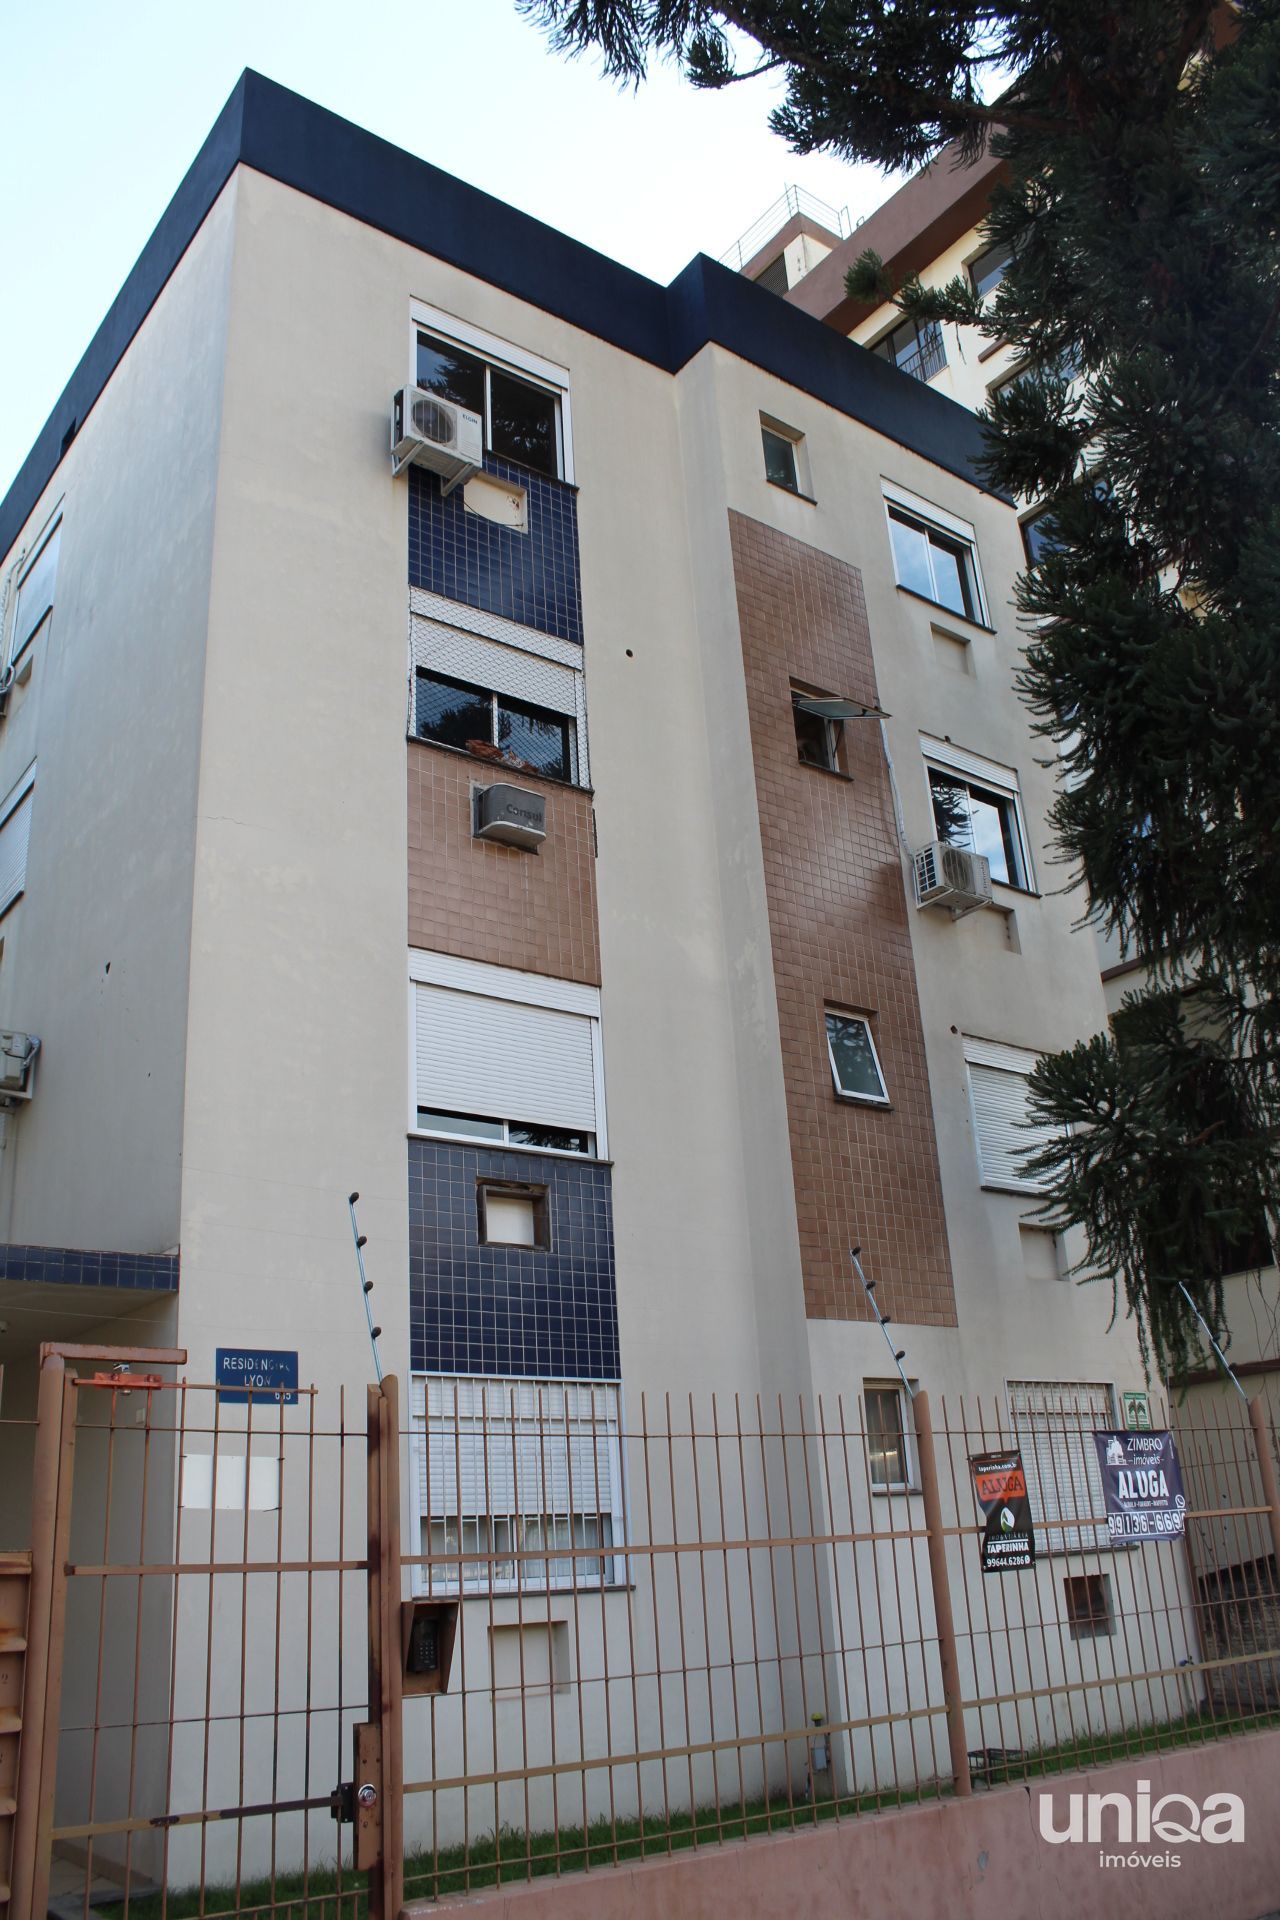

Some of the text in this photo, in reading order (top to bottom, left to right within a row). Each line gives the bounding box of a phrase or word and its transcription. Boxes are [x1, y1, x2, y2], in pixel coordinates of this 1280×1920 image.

[1127, 1437, 1163, 1451] ZIMBRO
[982, 1475, 1024, 1496] ALUGA
[1118, 1469, 1169, 1499] ALUGA
[987, 1541, 1029, 1554] TAPERINHA
